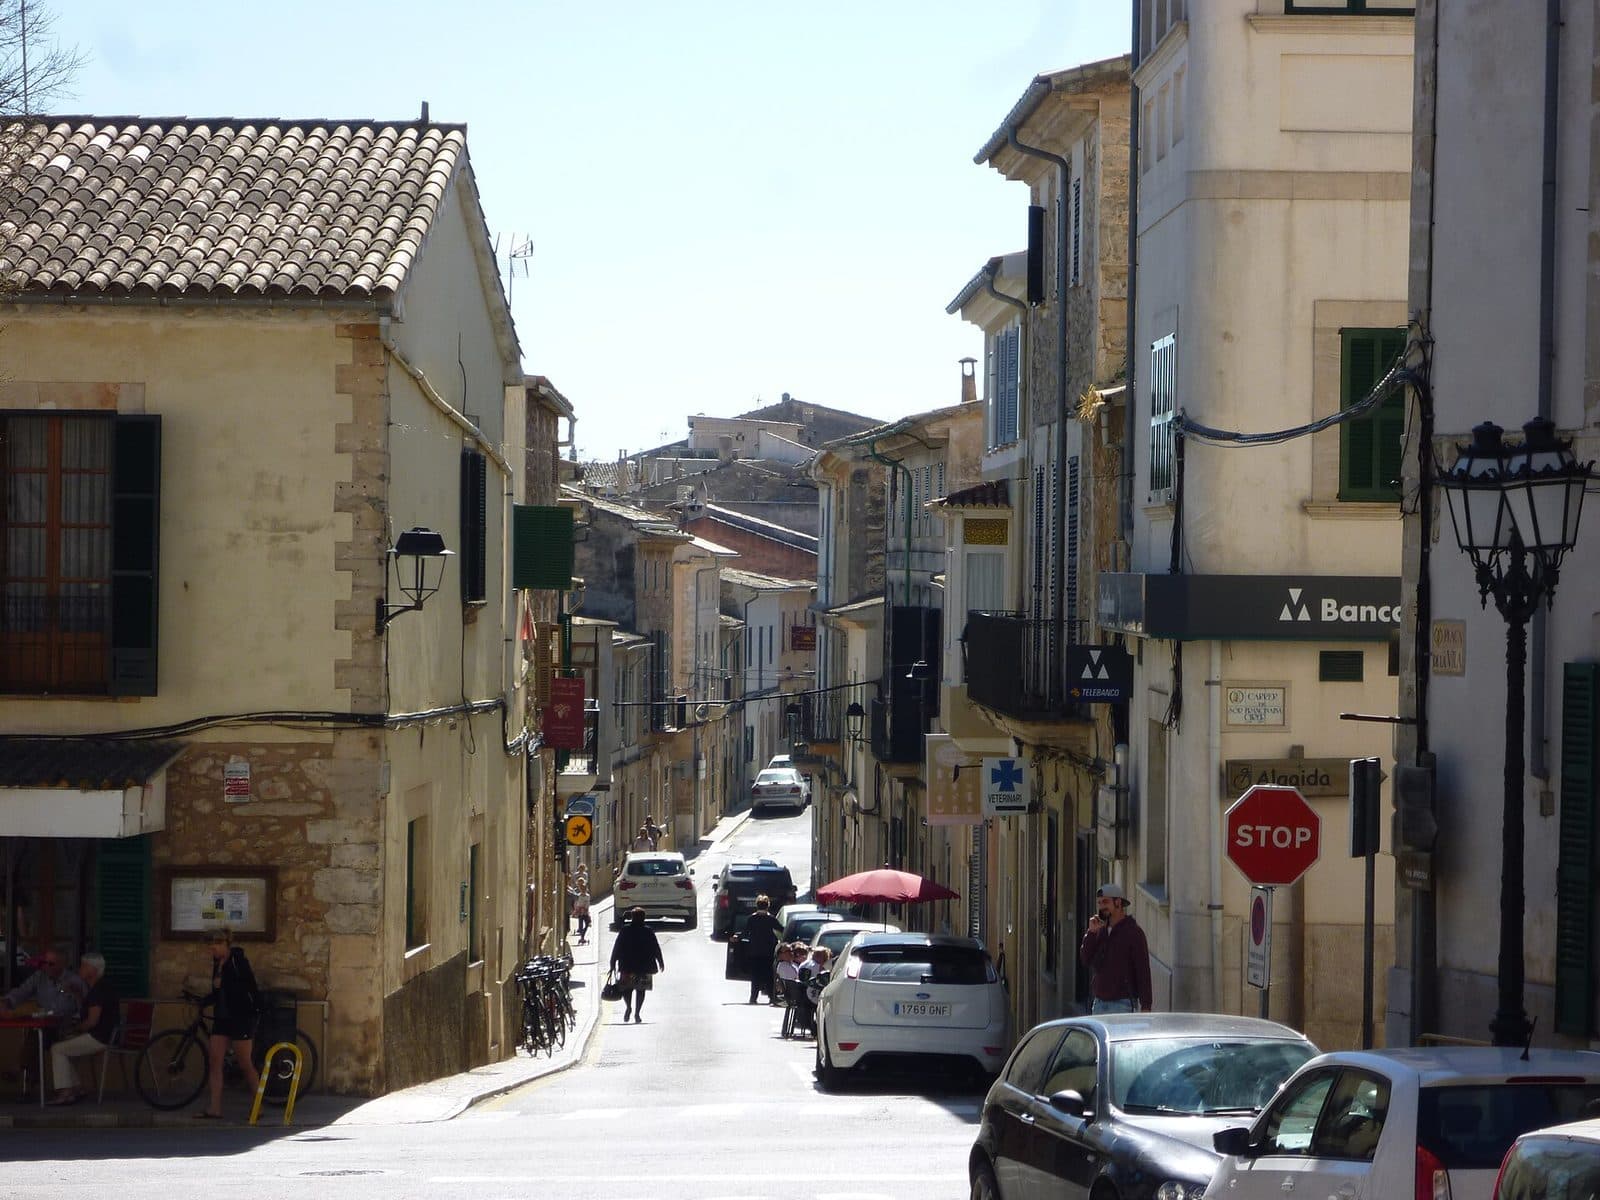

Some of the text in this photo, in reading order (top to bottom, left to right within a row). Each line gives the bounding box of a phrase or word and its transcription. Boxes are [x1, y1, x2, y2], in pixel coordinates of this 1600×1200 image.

[1082, 688, 1120, 697] TELEBANCO
[1235, 824, 1312, 849] STOP
[902, 1004, 949, 1017] 1769 GNF
